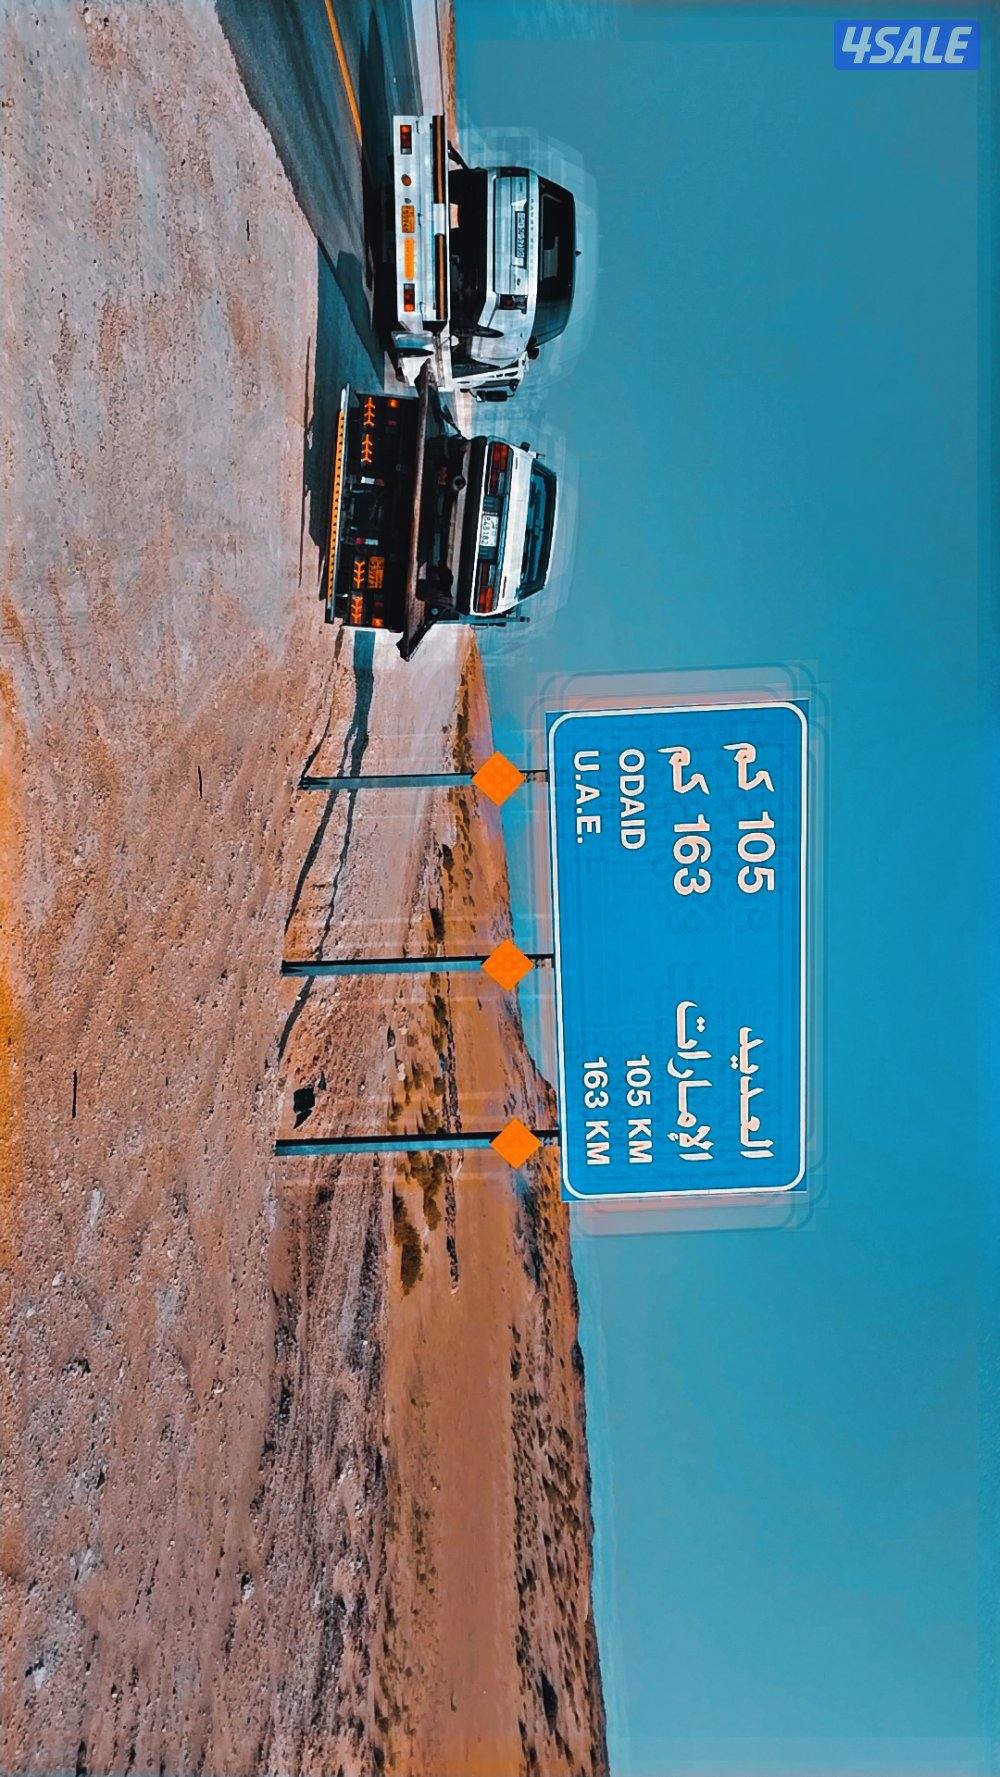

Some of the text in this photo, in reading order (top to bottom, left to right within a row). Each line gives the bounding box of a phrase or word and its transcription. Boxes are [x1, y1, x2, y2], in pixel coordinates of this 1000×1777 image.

[573, 751, 610, 1165] U.A.E. 163 KM
[618, 749, 653, 1164] ODAID 105 KM
[658, 747, 713, 1160] الإمارات 163 كم
[724, 743, 777, 1159] العديد 105 كم
